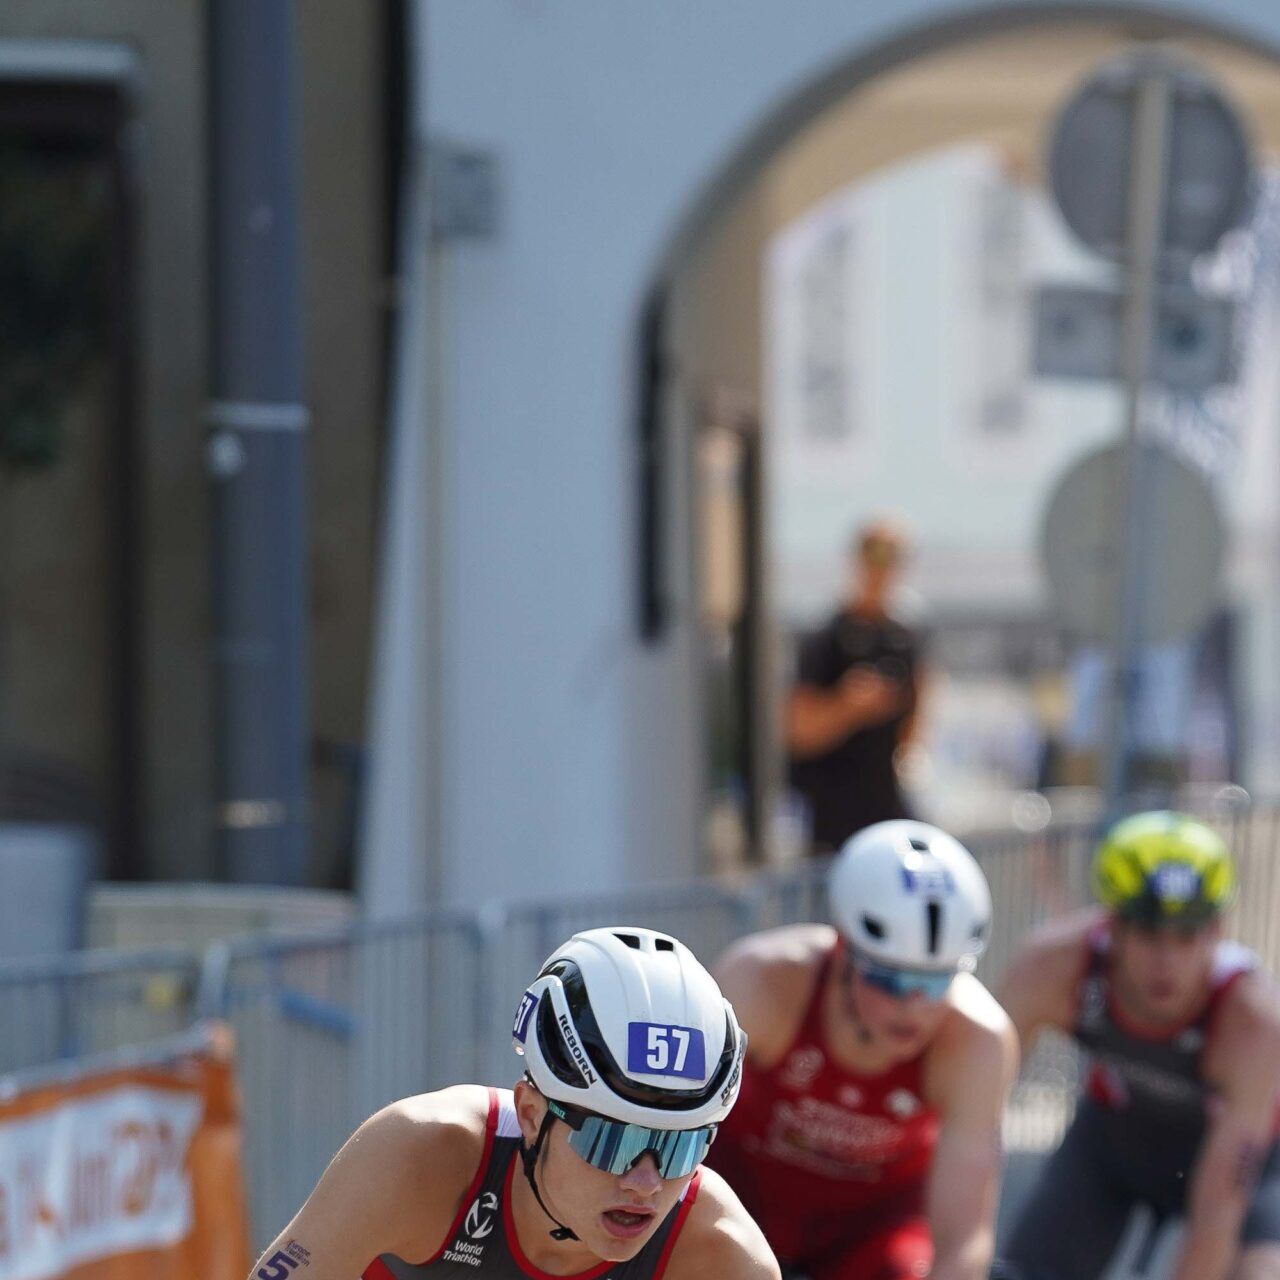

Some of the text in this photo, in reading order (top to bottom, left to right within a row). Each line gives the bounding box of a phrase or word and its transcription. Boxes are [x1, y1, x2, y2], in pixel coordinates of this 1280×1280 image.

[558, 1013, 598, 1086] REBORN
[646, 1026, 690, 1072] 57
[455, 1240, 484, 1255] World
